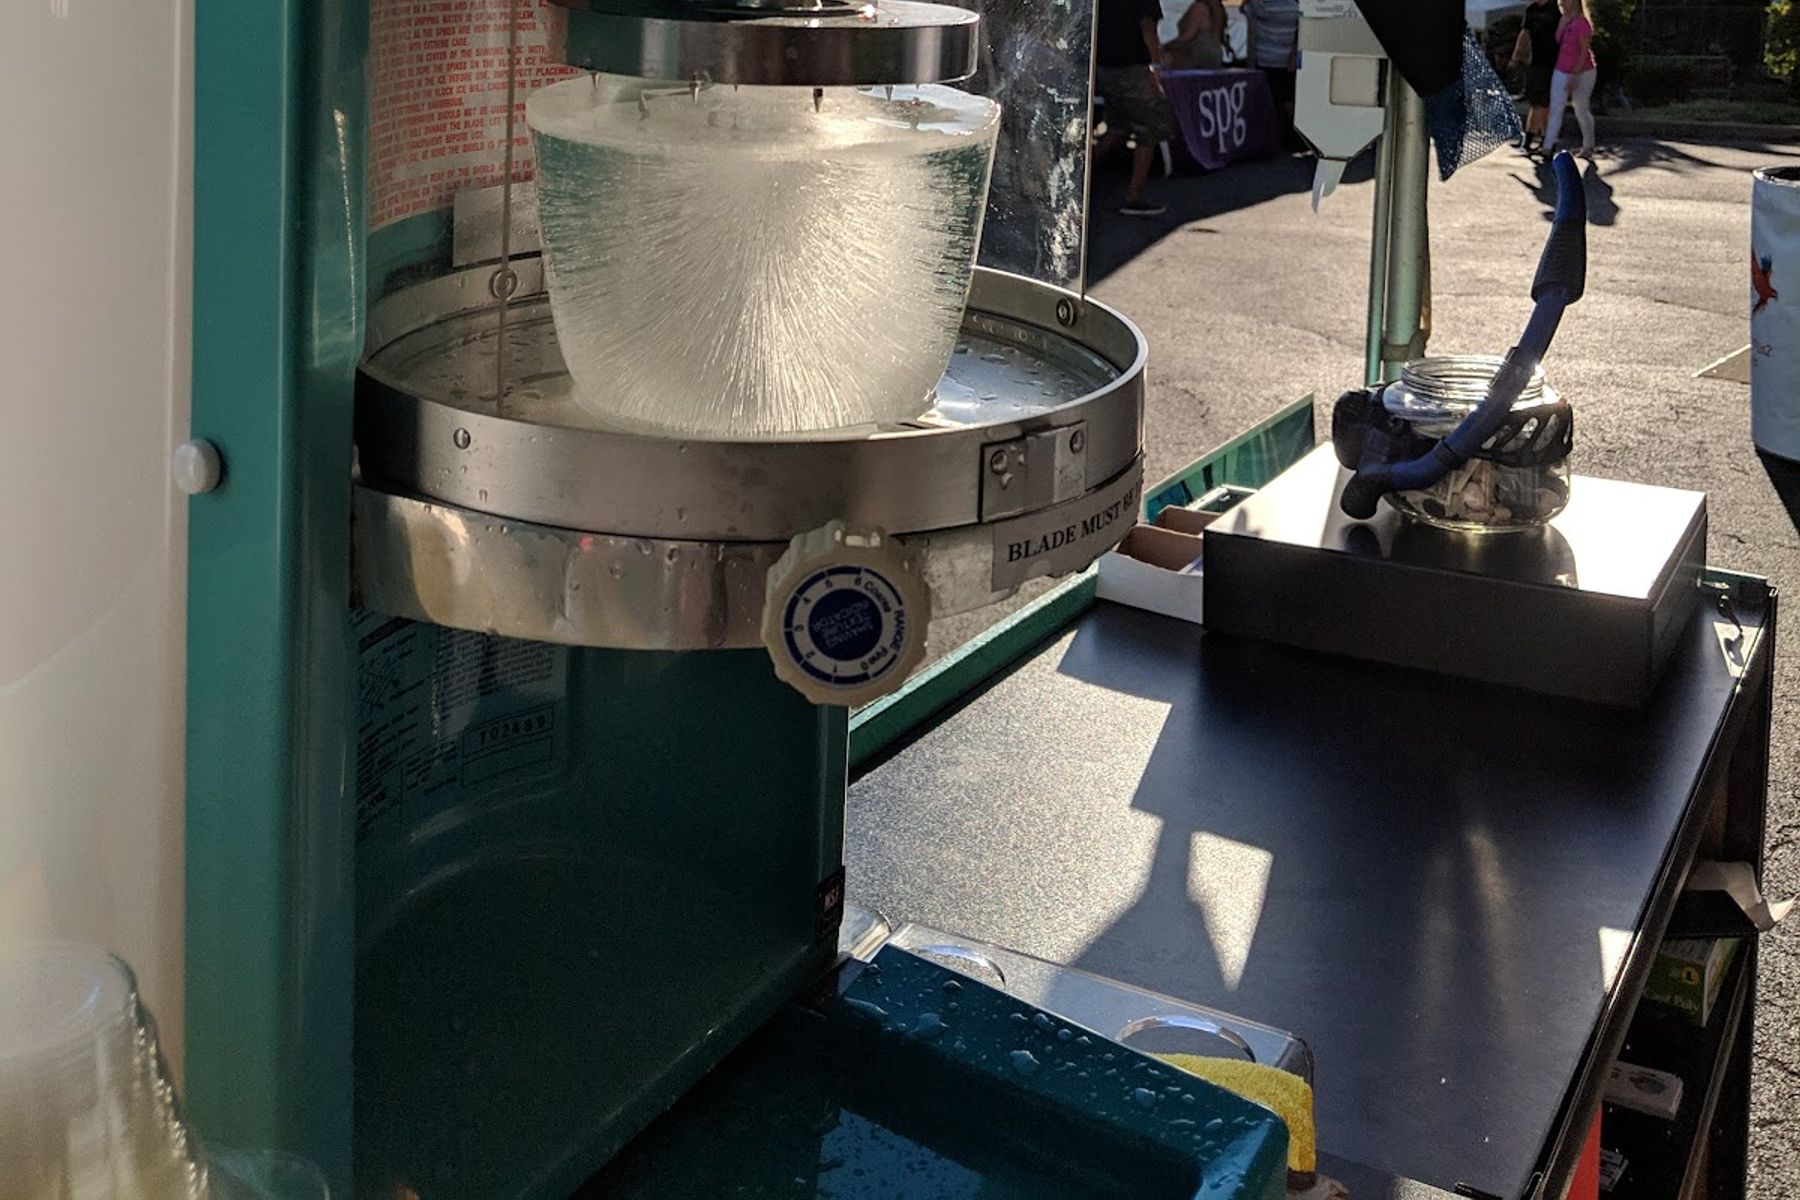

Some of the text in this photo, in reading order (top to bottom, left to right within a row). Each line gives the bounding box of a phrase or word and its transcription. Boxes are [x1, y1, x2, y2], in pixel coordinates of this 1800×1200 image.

[1198, 81, 1248, 154] spg
[1007, 524, 1077, 563] BLADE
[1080, 500, 1122, 538] MUST
[863, 580, 893, 613] Coarse
[889, 608, 906, 653] RANGE
